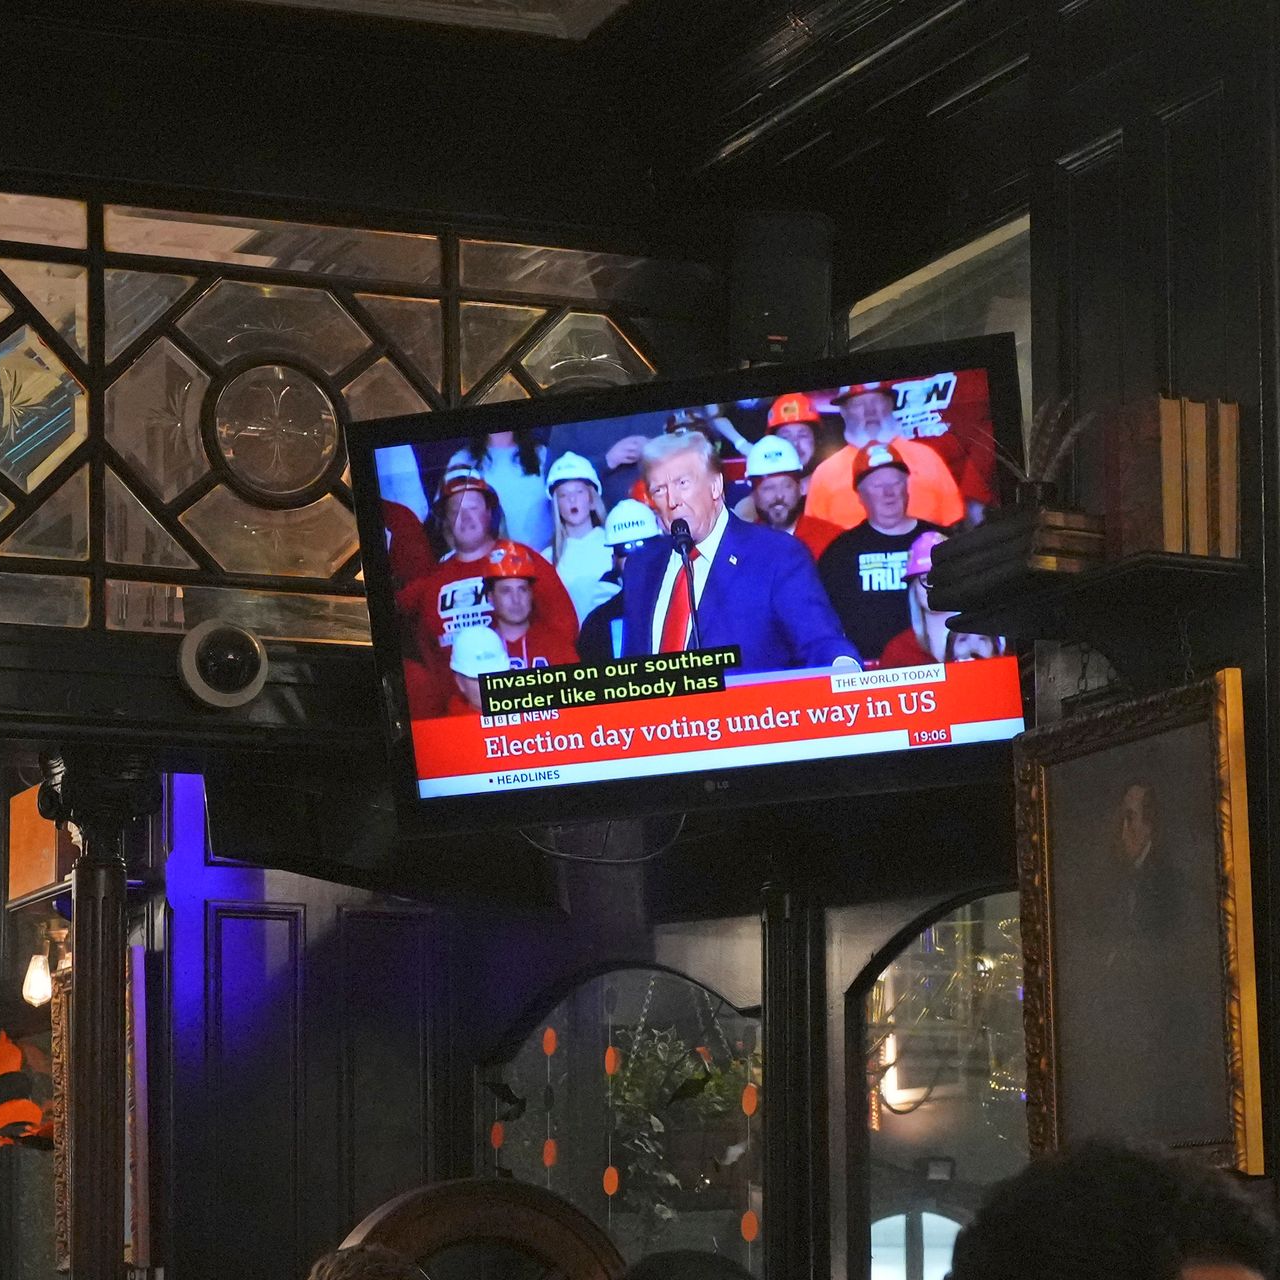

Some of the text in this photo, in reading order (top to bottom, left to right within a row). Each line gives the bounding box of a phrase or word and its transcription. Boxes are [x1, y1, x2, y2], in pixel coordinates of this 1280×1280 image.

[486, 650, 736, 690] invasion on our southern
[836, 668, 940, 688] THE WORLD TODAY
[490, 674, 718, 712] border like nobody has
[481, 709, 560, 728] BBC NEWS
[484, 690, 936, 759] Election day voting under way in US
[914, 730, 947, 743] 19:06
[497, 770, 560, 785] HEADLINES
